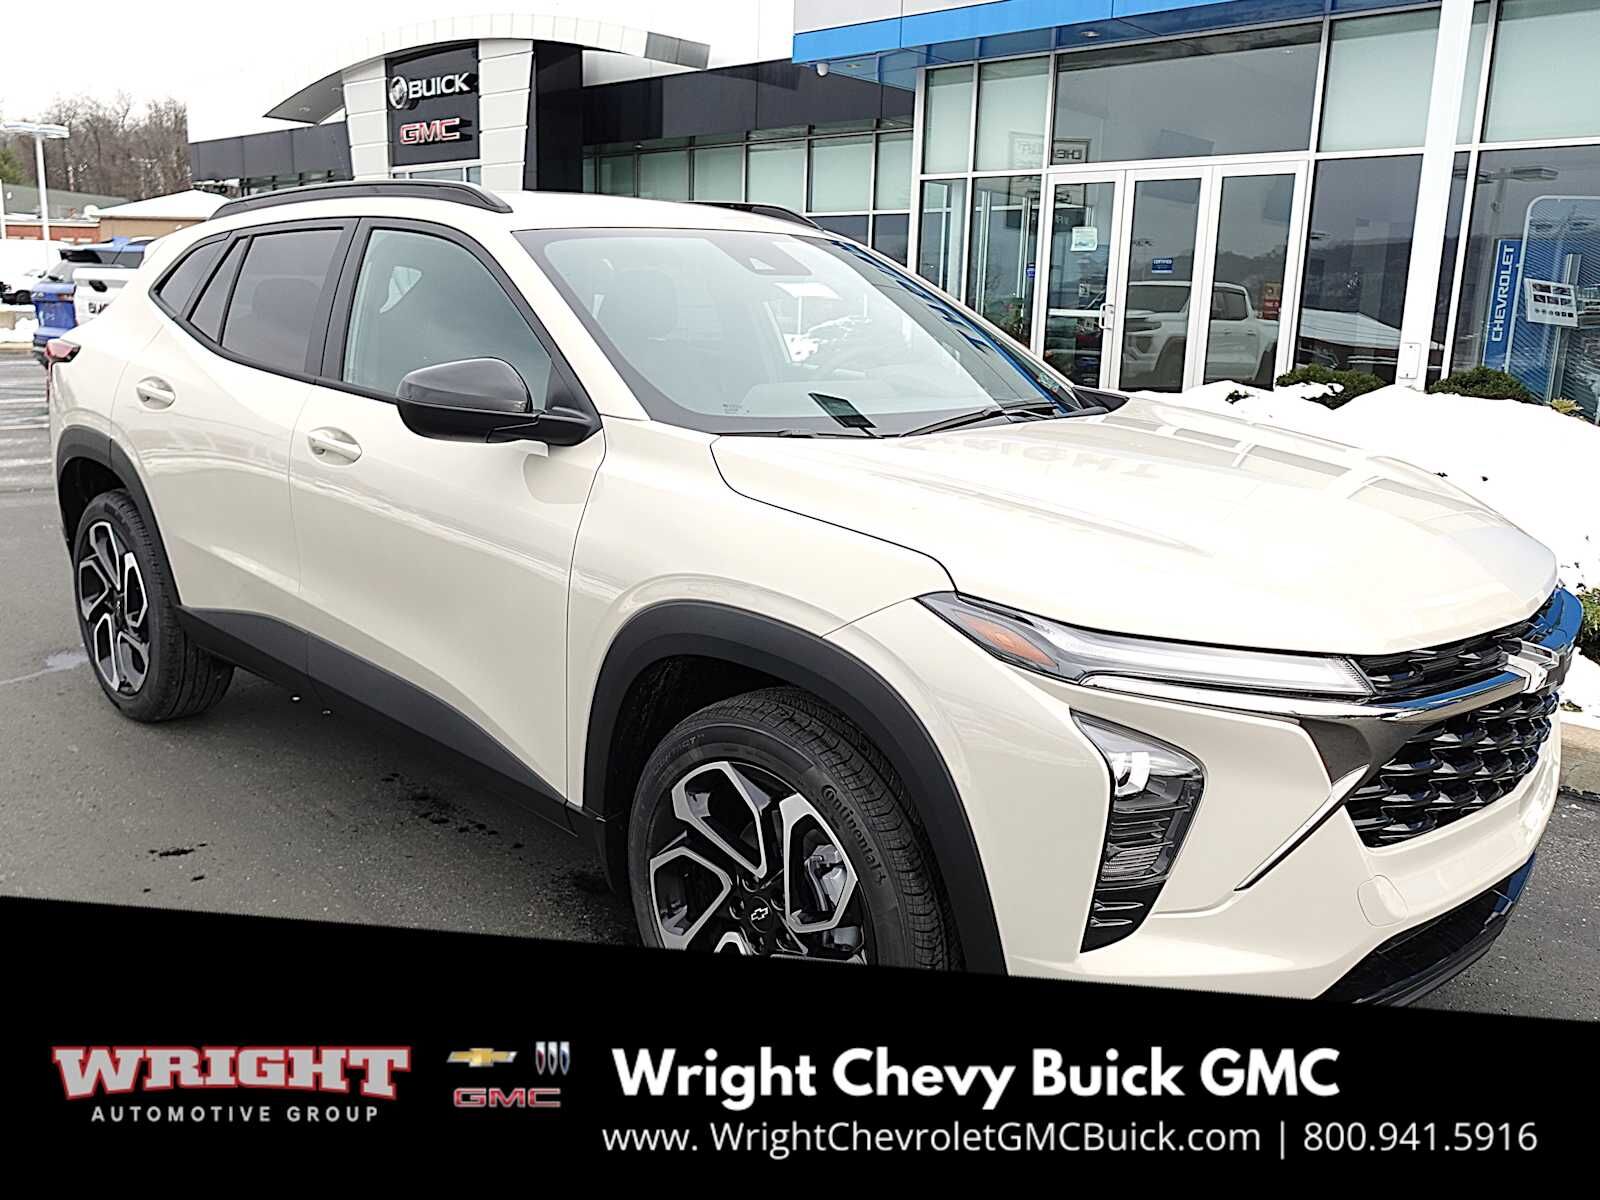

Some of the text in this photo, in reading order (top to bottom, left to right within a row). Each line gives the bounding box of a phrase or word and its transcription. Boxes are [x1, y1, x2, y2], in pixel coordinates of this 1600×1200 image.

[408, 72, 471, 99] BUICK
[400, 117, 460, 145] GMC
[1491, 244, 1515, 342] CHEVROLET
[821, 784, 883, 872] Continental
